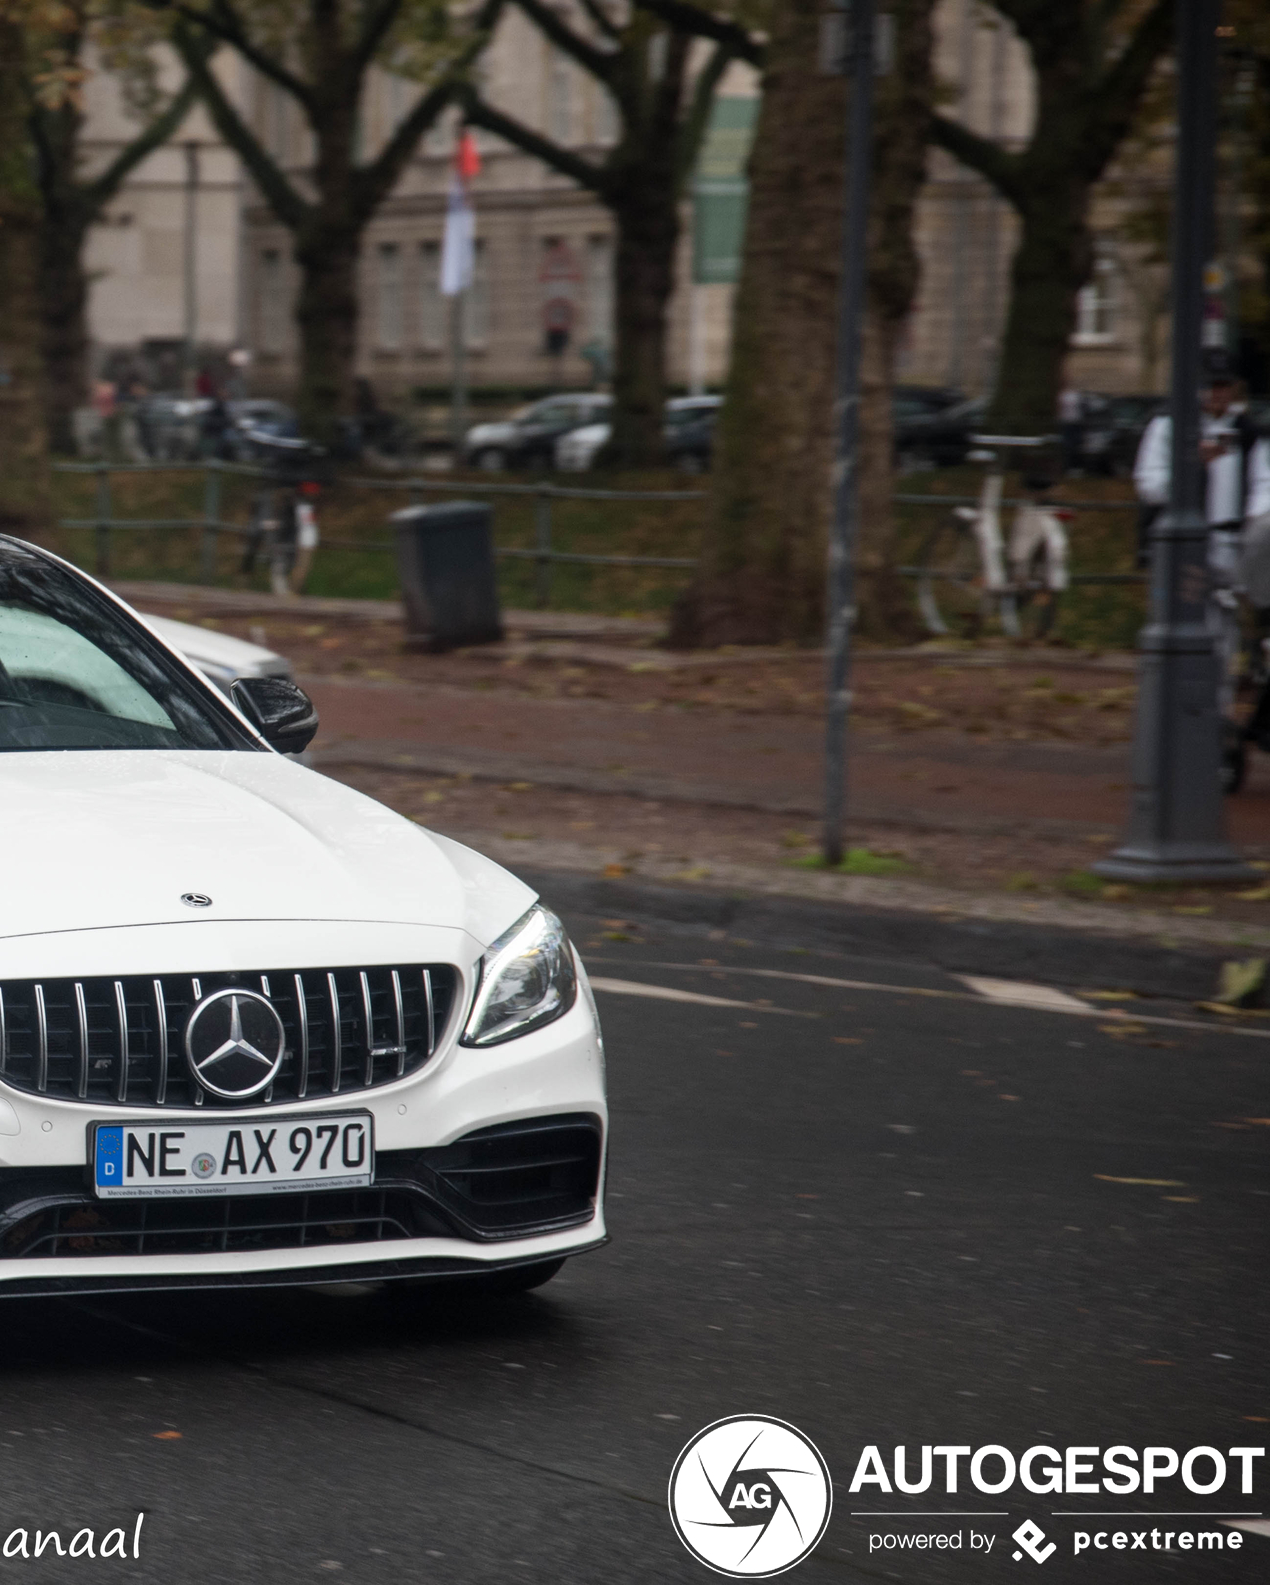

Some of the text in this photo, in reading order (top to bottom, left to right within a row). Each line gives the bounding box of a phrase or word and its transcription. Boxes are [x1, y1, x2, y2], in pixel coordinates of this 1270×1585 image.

[126, 1122, 366, 1178] NE AX 970
[104, 1162, 115, 1176] D
